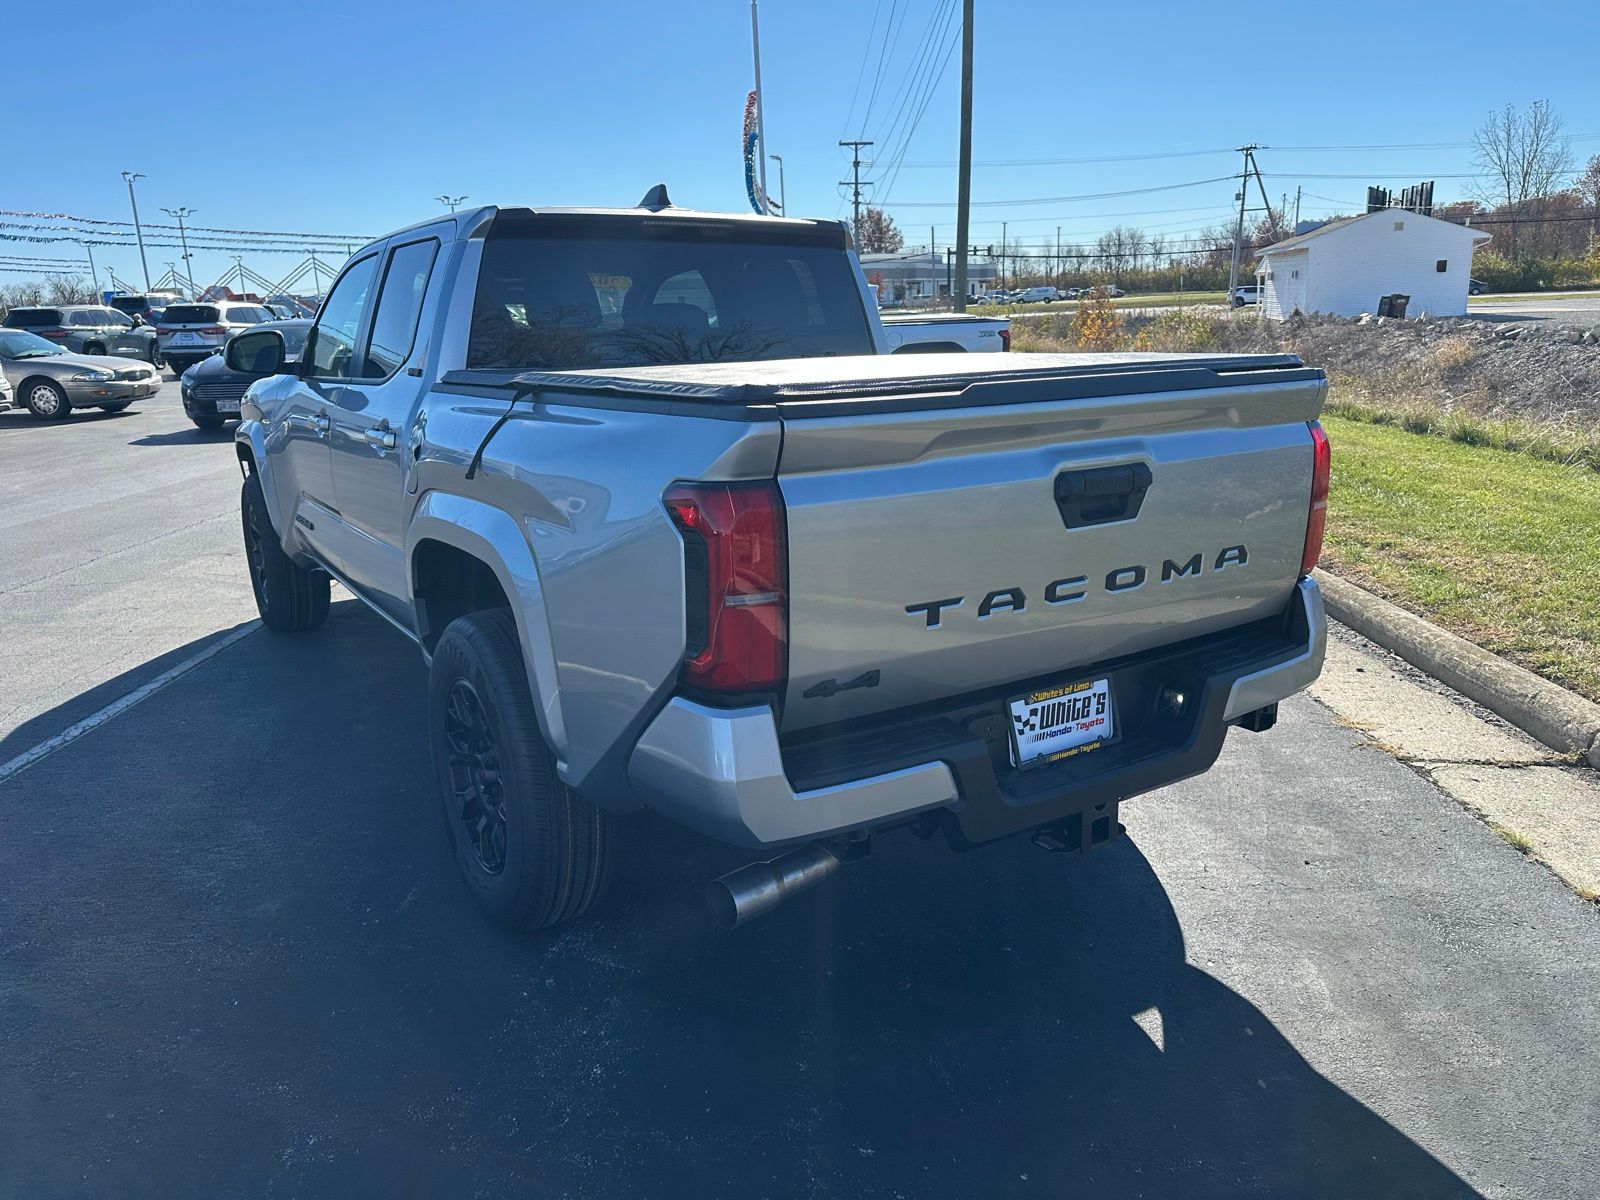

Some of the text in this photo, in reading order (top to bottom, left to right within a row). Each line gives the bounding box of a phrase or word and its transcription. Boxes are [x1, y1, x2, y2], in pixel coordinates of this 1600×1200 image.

[905, 544, 1248, 630] TACOMA
[1037, 681, 1090, 701] White's of Lima
[1040, 692, 1106, 730] White's
[1046, 717, 1105, 739] Honda Toyota
[1059, 742, 1100, 759] Honda Toyota
